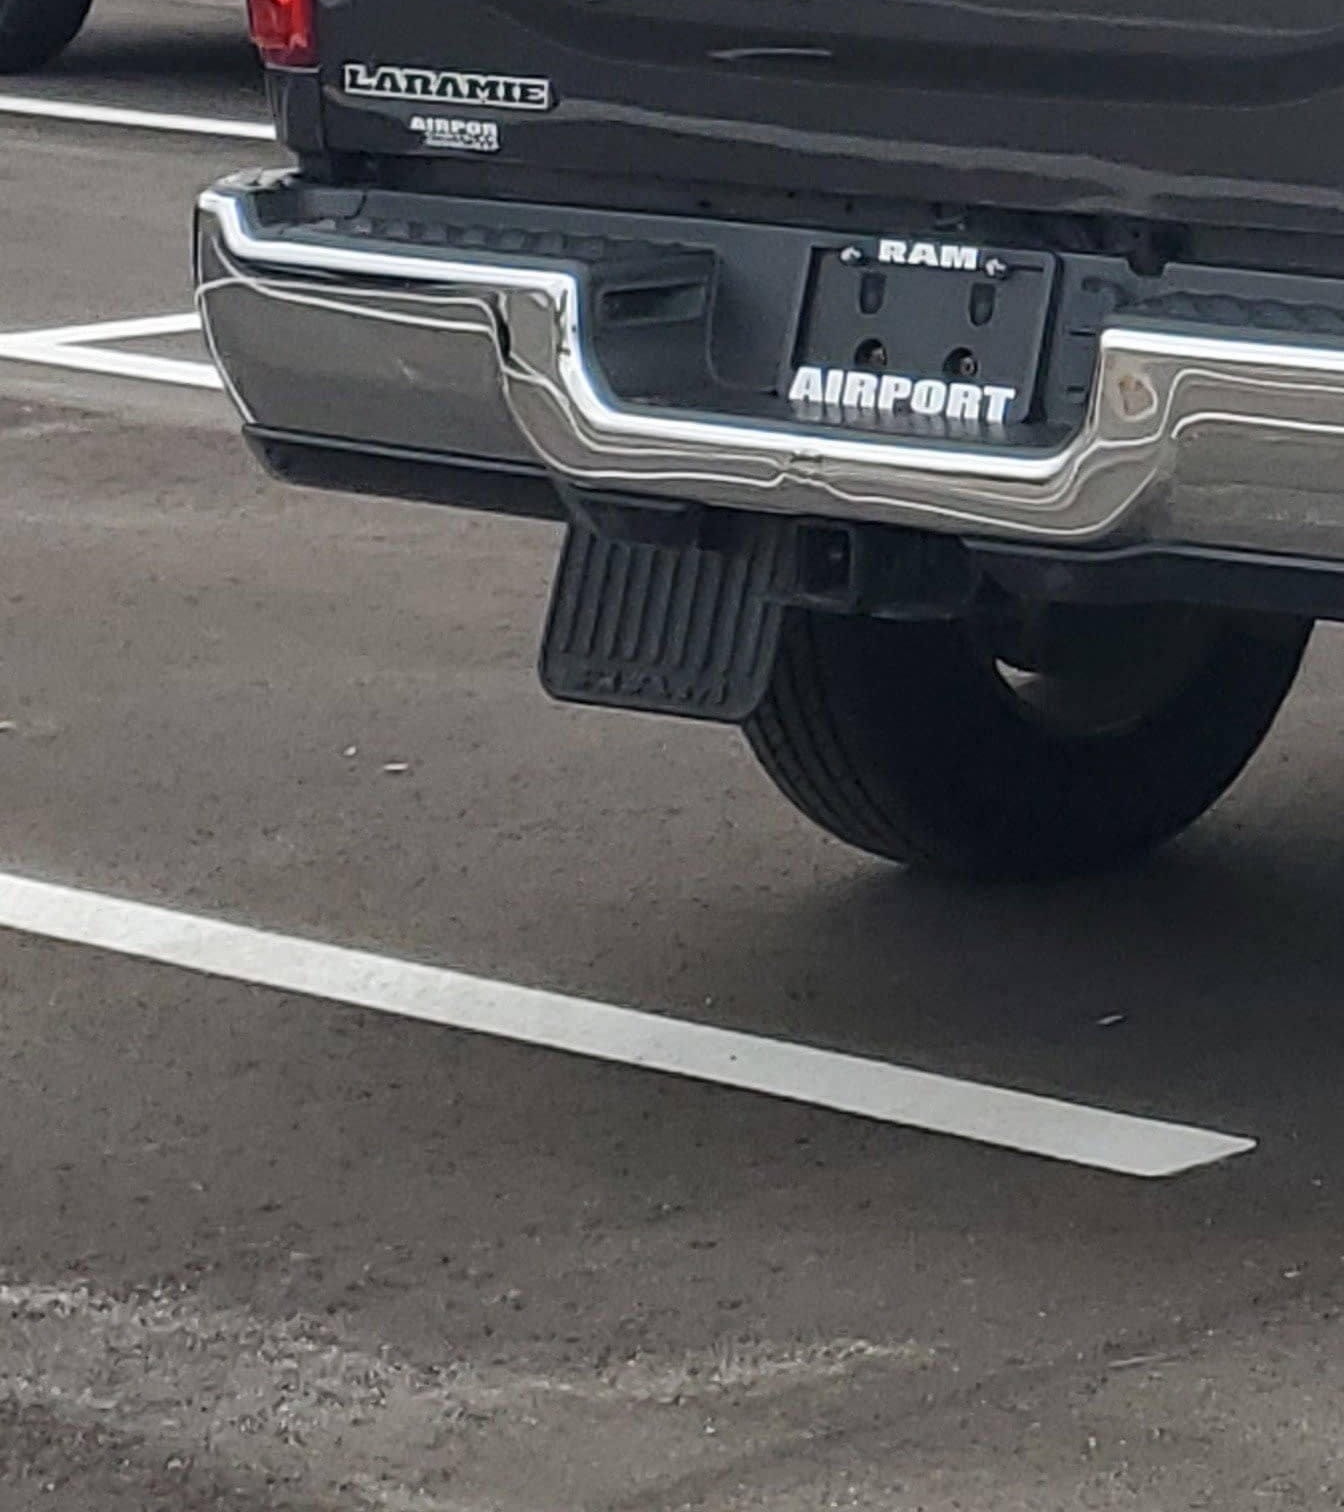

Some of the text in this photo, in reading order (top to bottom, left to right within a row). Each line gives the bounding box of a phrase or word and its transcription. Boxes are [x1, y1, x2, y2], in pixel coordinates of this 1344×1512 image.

[346, 68, 549, 105] LARAMIE
[878, 238, 979, 270] RAM
[788, 366, 1016, 423] AIRPORT
